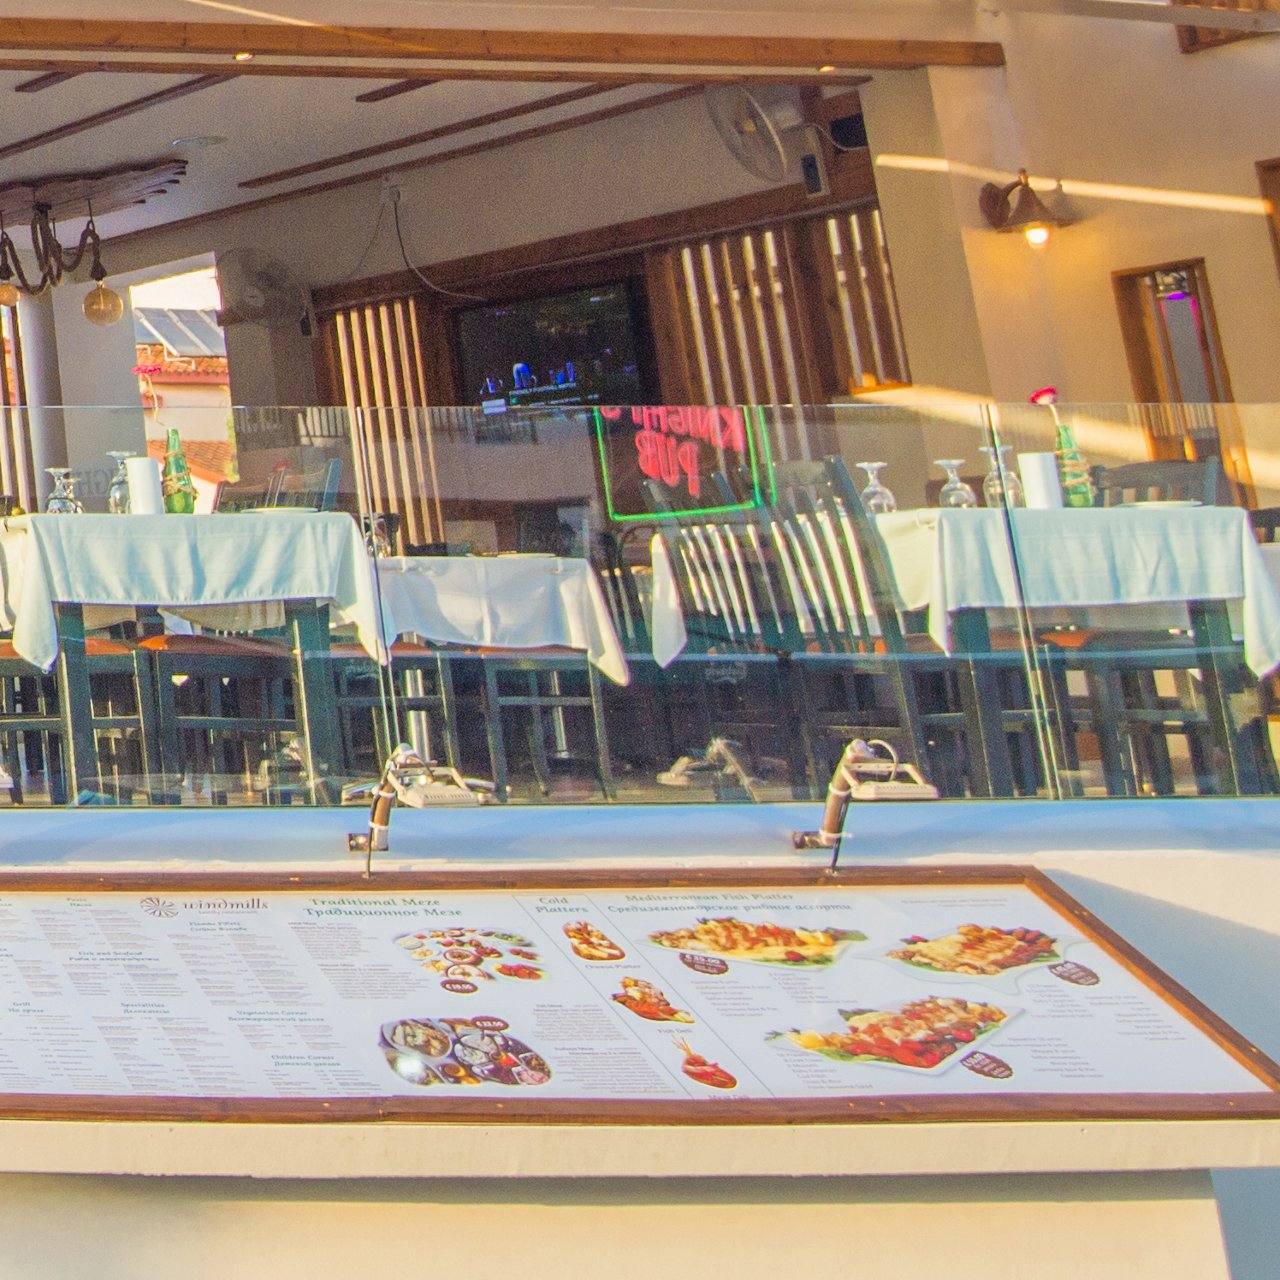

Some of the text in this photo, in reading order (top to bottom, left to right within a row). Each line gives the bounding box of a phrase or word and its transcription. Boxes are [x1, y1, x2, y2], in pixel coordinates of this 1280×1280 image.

[308, 897, 441, 907] Traditional Meze
[538, 897, 569, 905] Cold
[625, 894, 718, 903] Mediterranean
[752, 893, 794, 901] Platter
[182, 897, 269, 910] windmills
[535, 906, 589, 914] Platters
